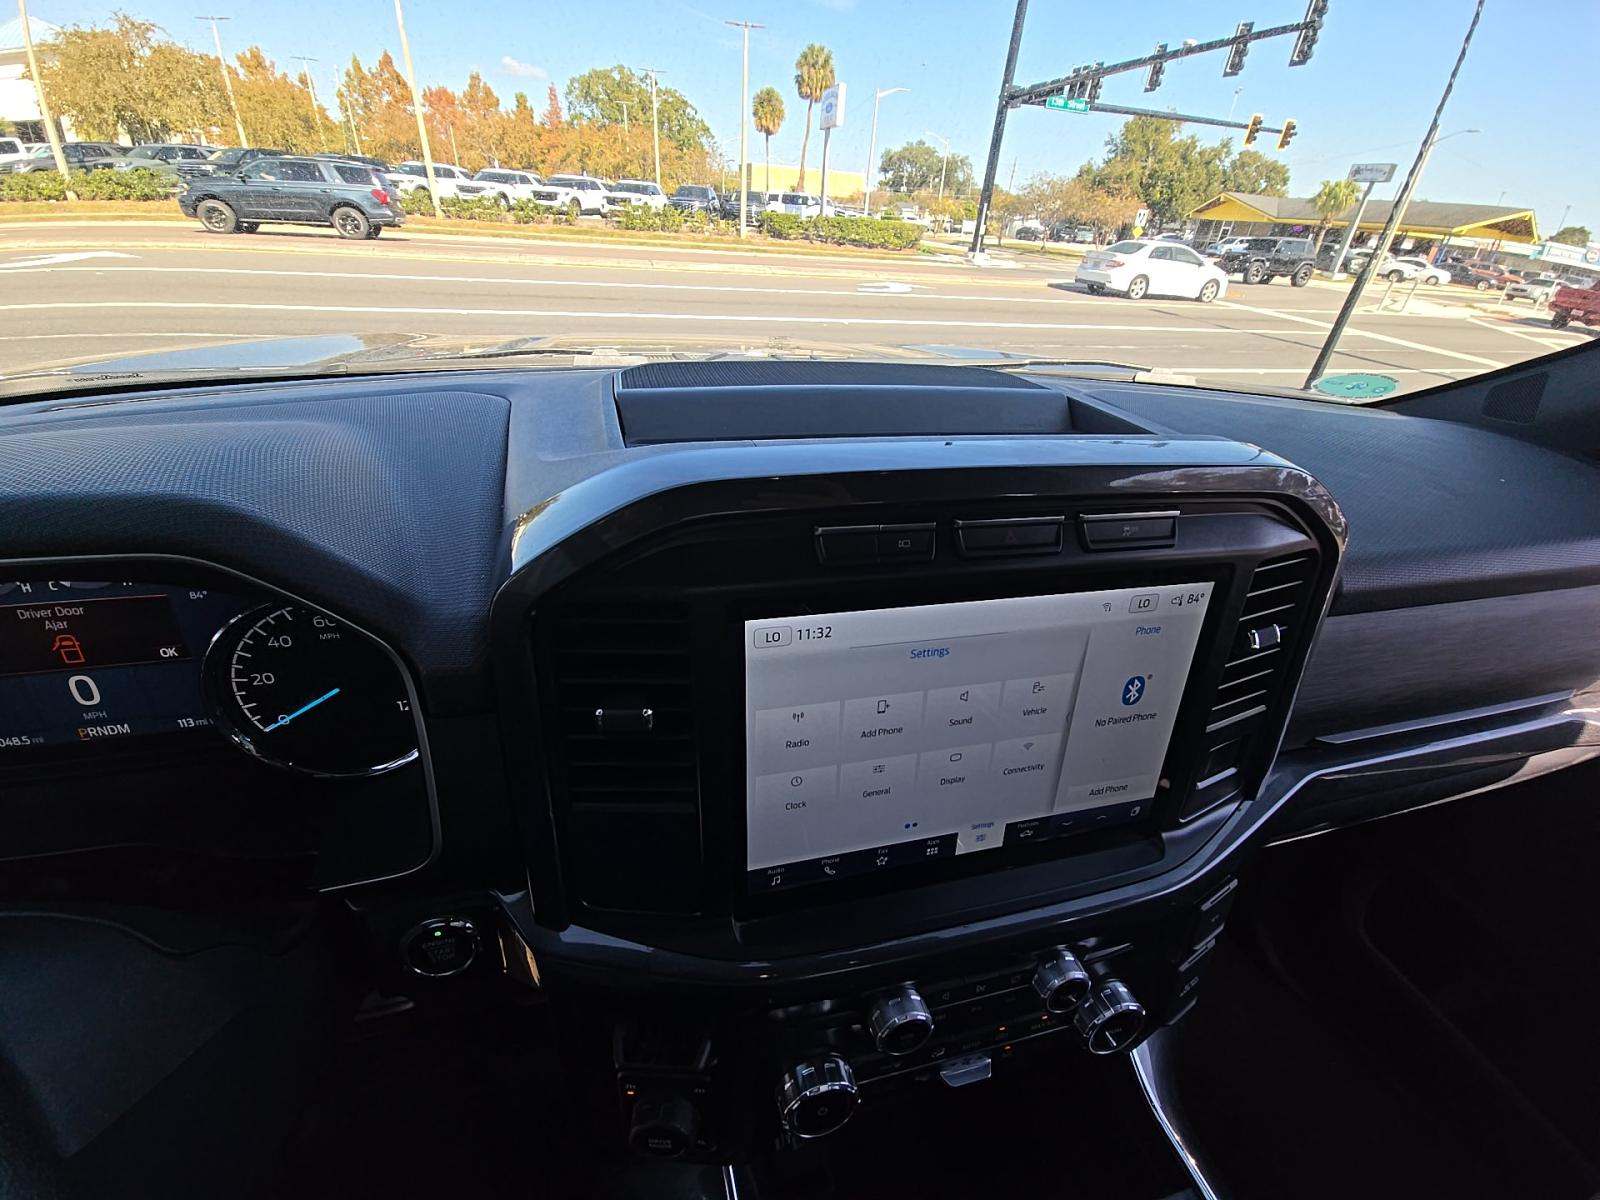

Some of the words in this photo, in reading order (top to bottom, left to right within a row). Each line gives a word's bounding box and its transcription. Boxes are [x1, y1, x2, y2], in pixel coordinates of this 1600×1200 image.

[1137, 599, 1150, 609] LO
[17, 607, 52, 620] Driver
[54, 606, 84, 617] Door
[45, 620, 69, 631] Ajar
[1135, 625, 1162, 636] Phone
[765, 632, 781, 643] LO
[797, 626, 832, 641] 11:32
[267, 635, 292, 648] 40
[160, 647, 178, 658] OK
[910, 647, 950, 660] Settings
[250, 673, 275, 685] 20
[68, 675, 100, 706] 0
[83, 711, 107, 720] MPH
[1023, 707, 1048, 717] Vehicle
[177, 718, 195, 728] 113
[949, 716, 973, 726] Sound
[1094, 719, 1106, 727] No
[1107, 715, 1132, 725] Paired
[1133, 713, 1158, 721] Phone
[860, 729, 877, 739] Add
[878, 726, 903, 736] Phone
[785, 738, 810, 749] Radio
[1003, 763, 1046, 776] Connectivity
[940, 775, 966, 786] Display
[862, 787, 891, 798] General
[1105, 784, 1129, 793] Phone
[785, 801, 807, 811] Clock
